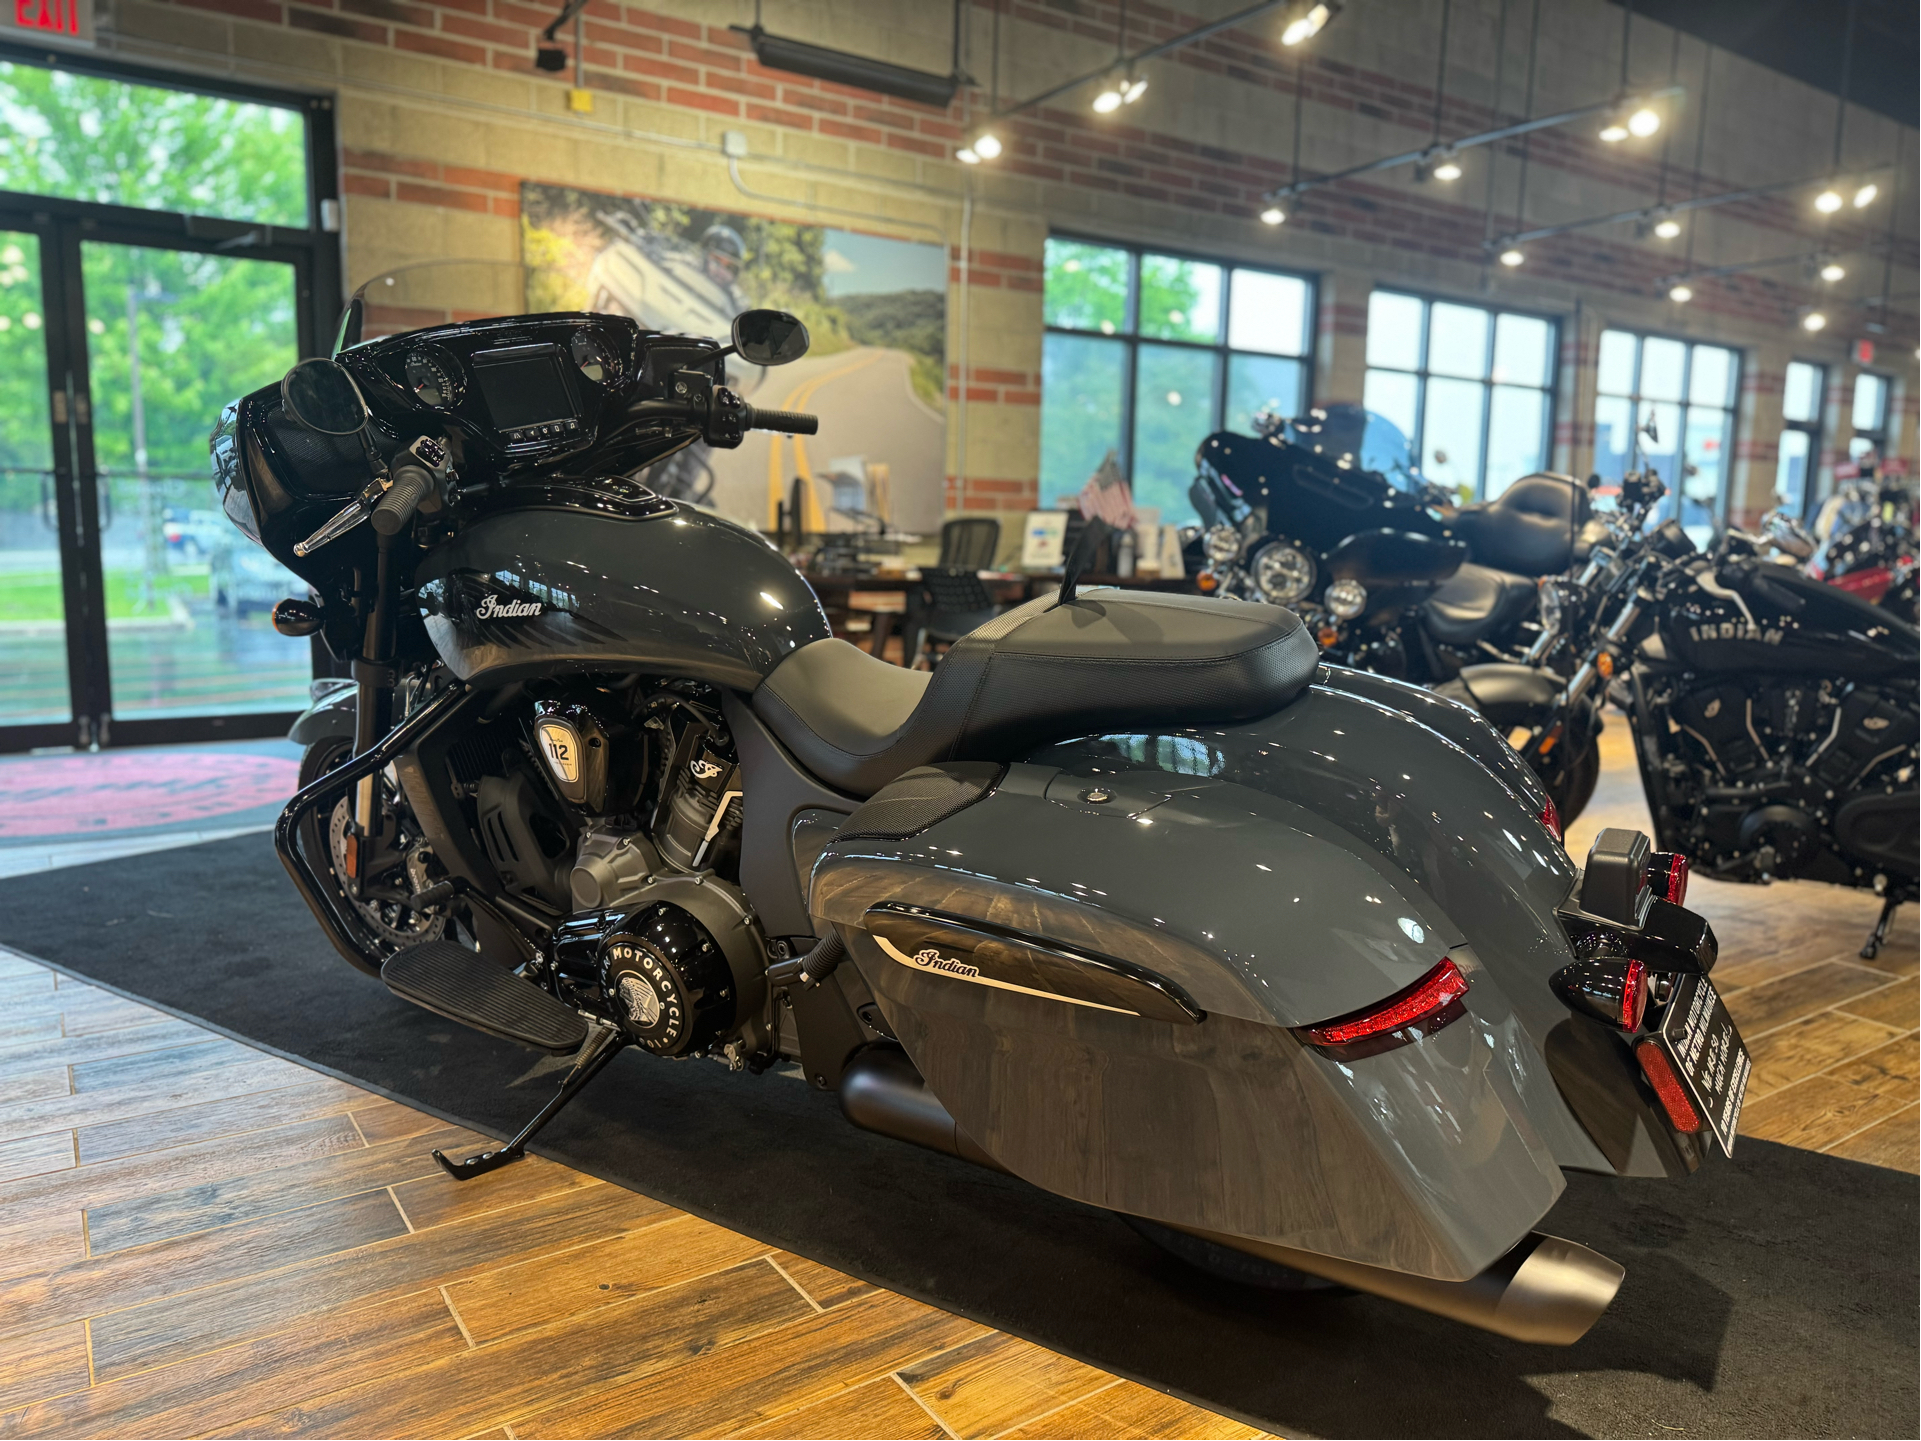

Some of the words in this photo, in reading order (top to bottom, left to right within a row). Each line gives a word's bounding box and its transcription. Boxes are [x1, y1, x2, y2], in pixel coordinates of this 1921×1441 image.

[15, 0, 79, 36] EXIT
[476, 594, 542, 619] Indian
[1689, 622, 1784, 646] INDIAN
[549, 743, 569, 760] 112
[914, 950, 979, 978] Indian
[613, 946, 680, 1038] MOTORCYCLE
[1687, 976, 1708, 1030] MOTORCYCLE
[1699, 986, 1717, 1035] MILWAUKEE
[1689, 1029, 1704, 1064] METRO
[1711, 1033, 1719, 1053] SO
[1685, 1056, 1695, 1076] OF
[1706, 1048, 1717, 1076] ARE
[1730, 1048, 1745, 1093] EXCELLENCE
[1701, 1070, 1712, 1092] WE
[1714, 1060, 1726, 1095] MUCH
[1728, 1086, 1734, 1103] OF
[1722, 1096, 1732, 1126] YEARS
